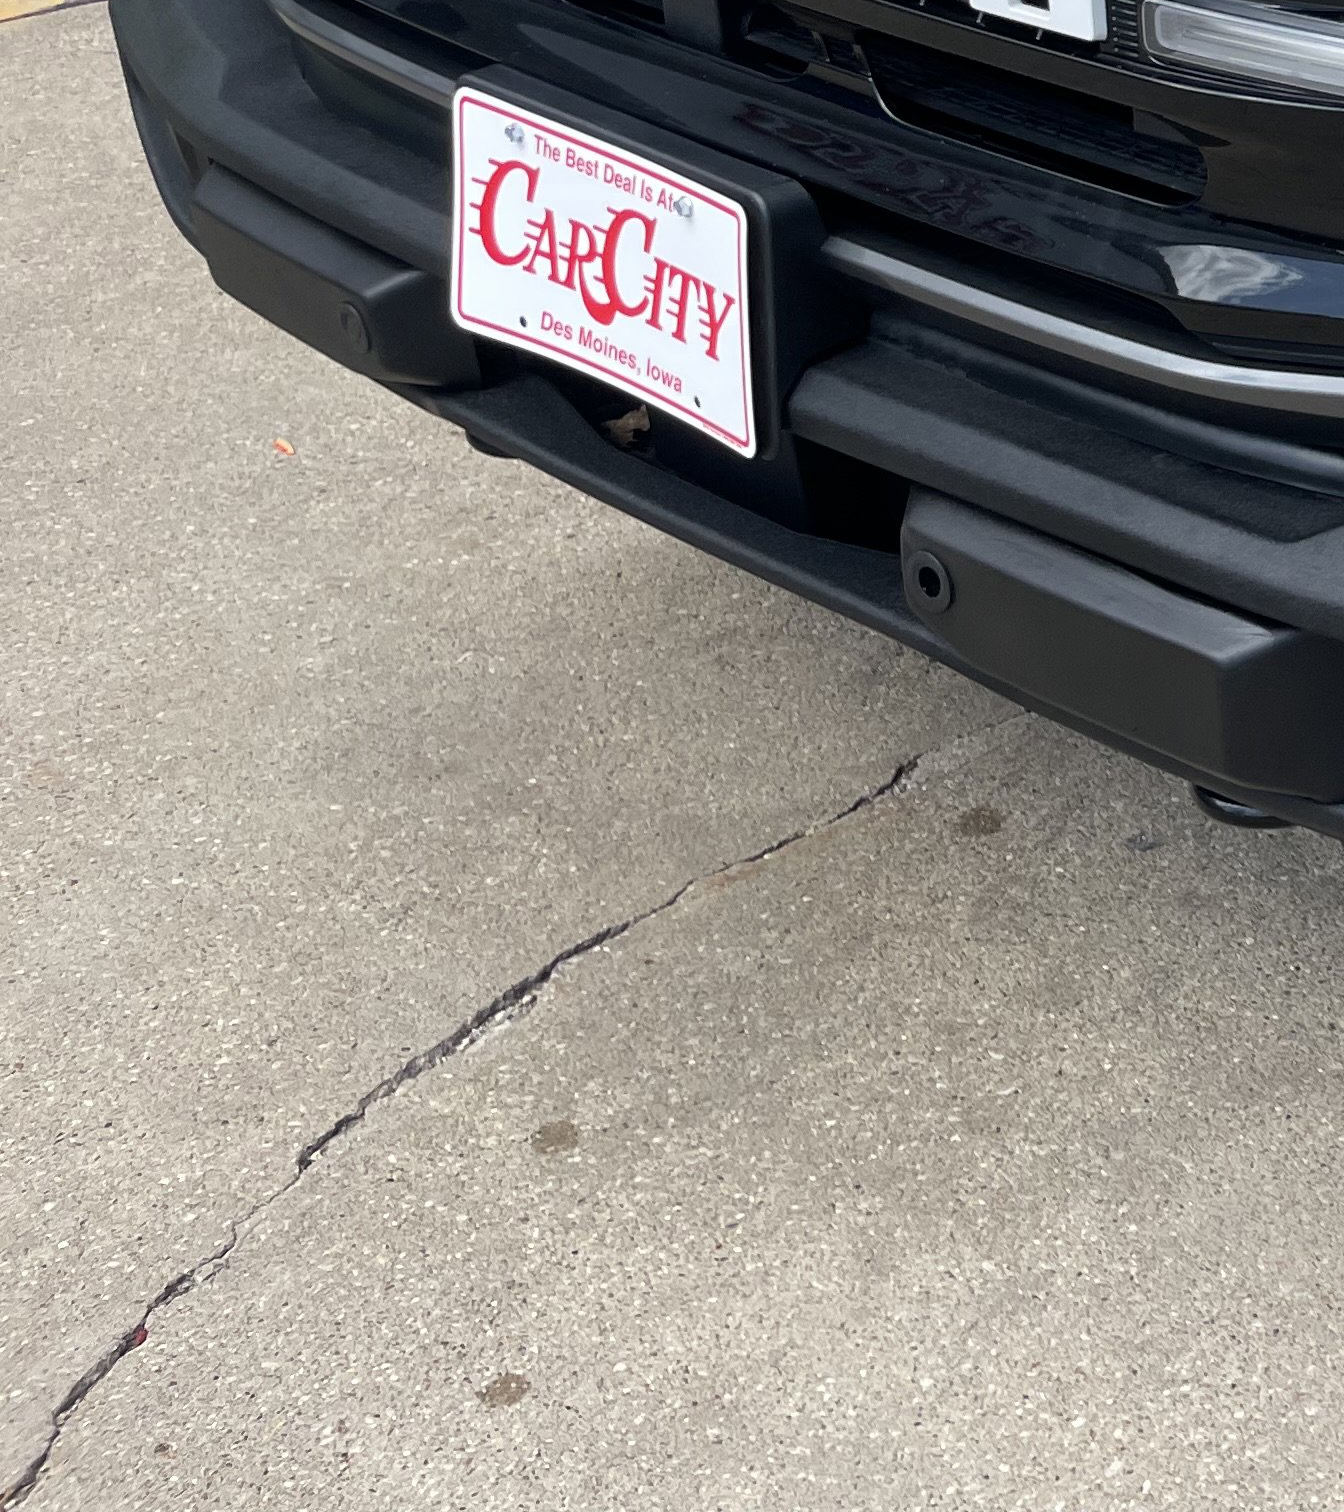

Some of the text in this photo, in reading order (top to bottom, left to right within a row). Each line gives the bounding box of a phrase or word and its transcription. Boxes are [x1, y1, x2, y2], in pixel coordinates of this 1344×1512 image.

[533, 134, 674, 212] The Best Deal Is At
[540, 311, 682, 393] Des Moines, Iowa
